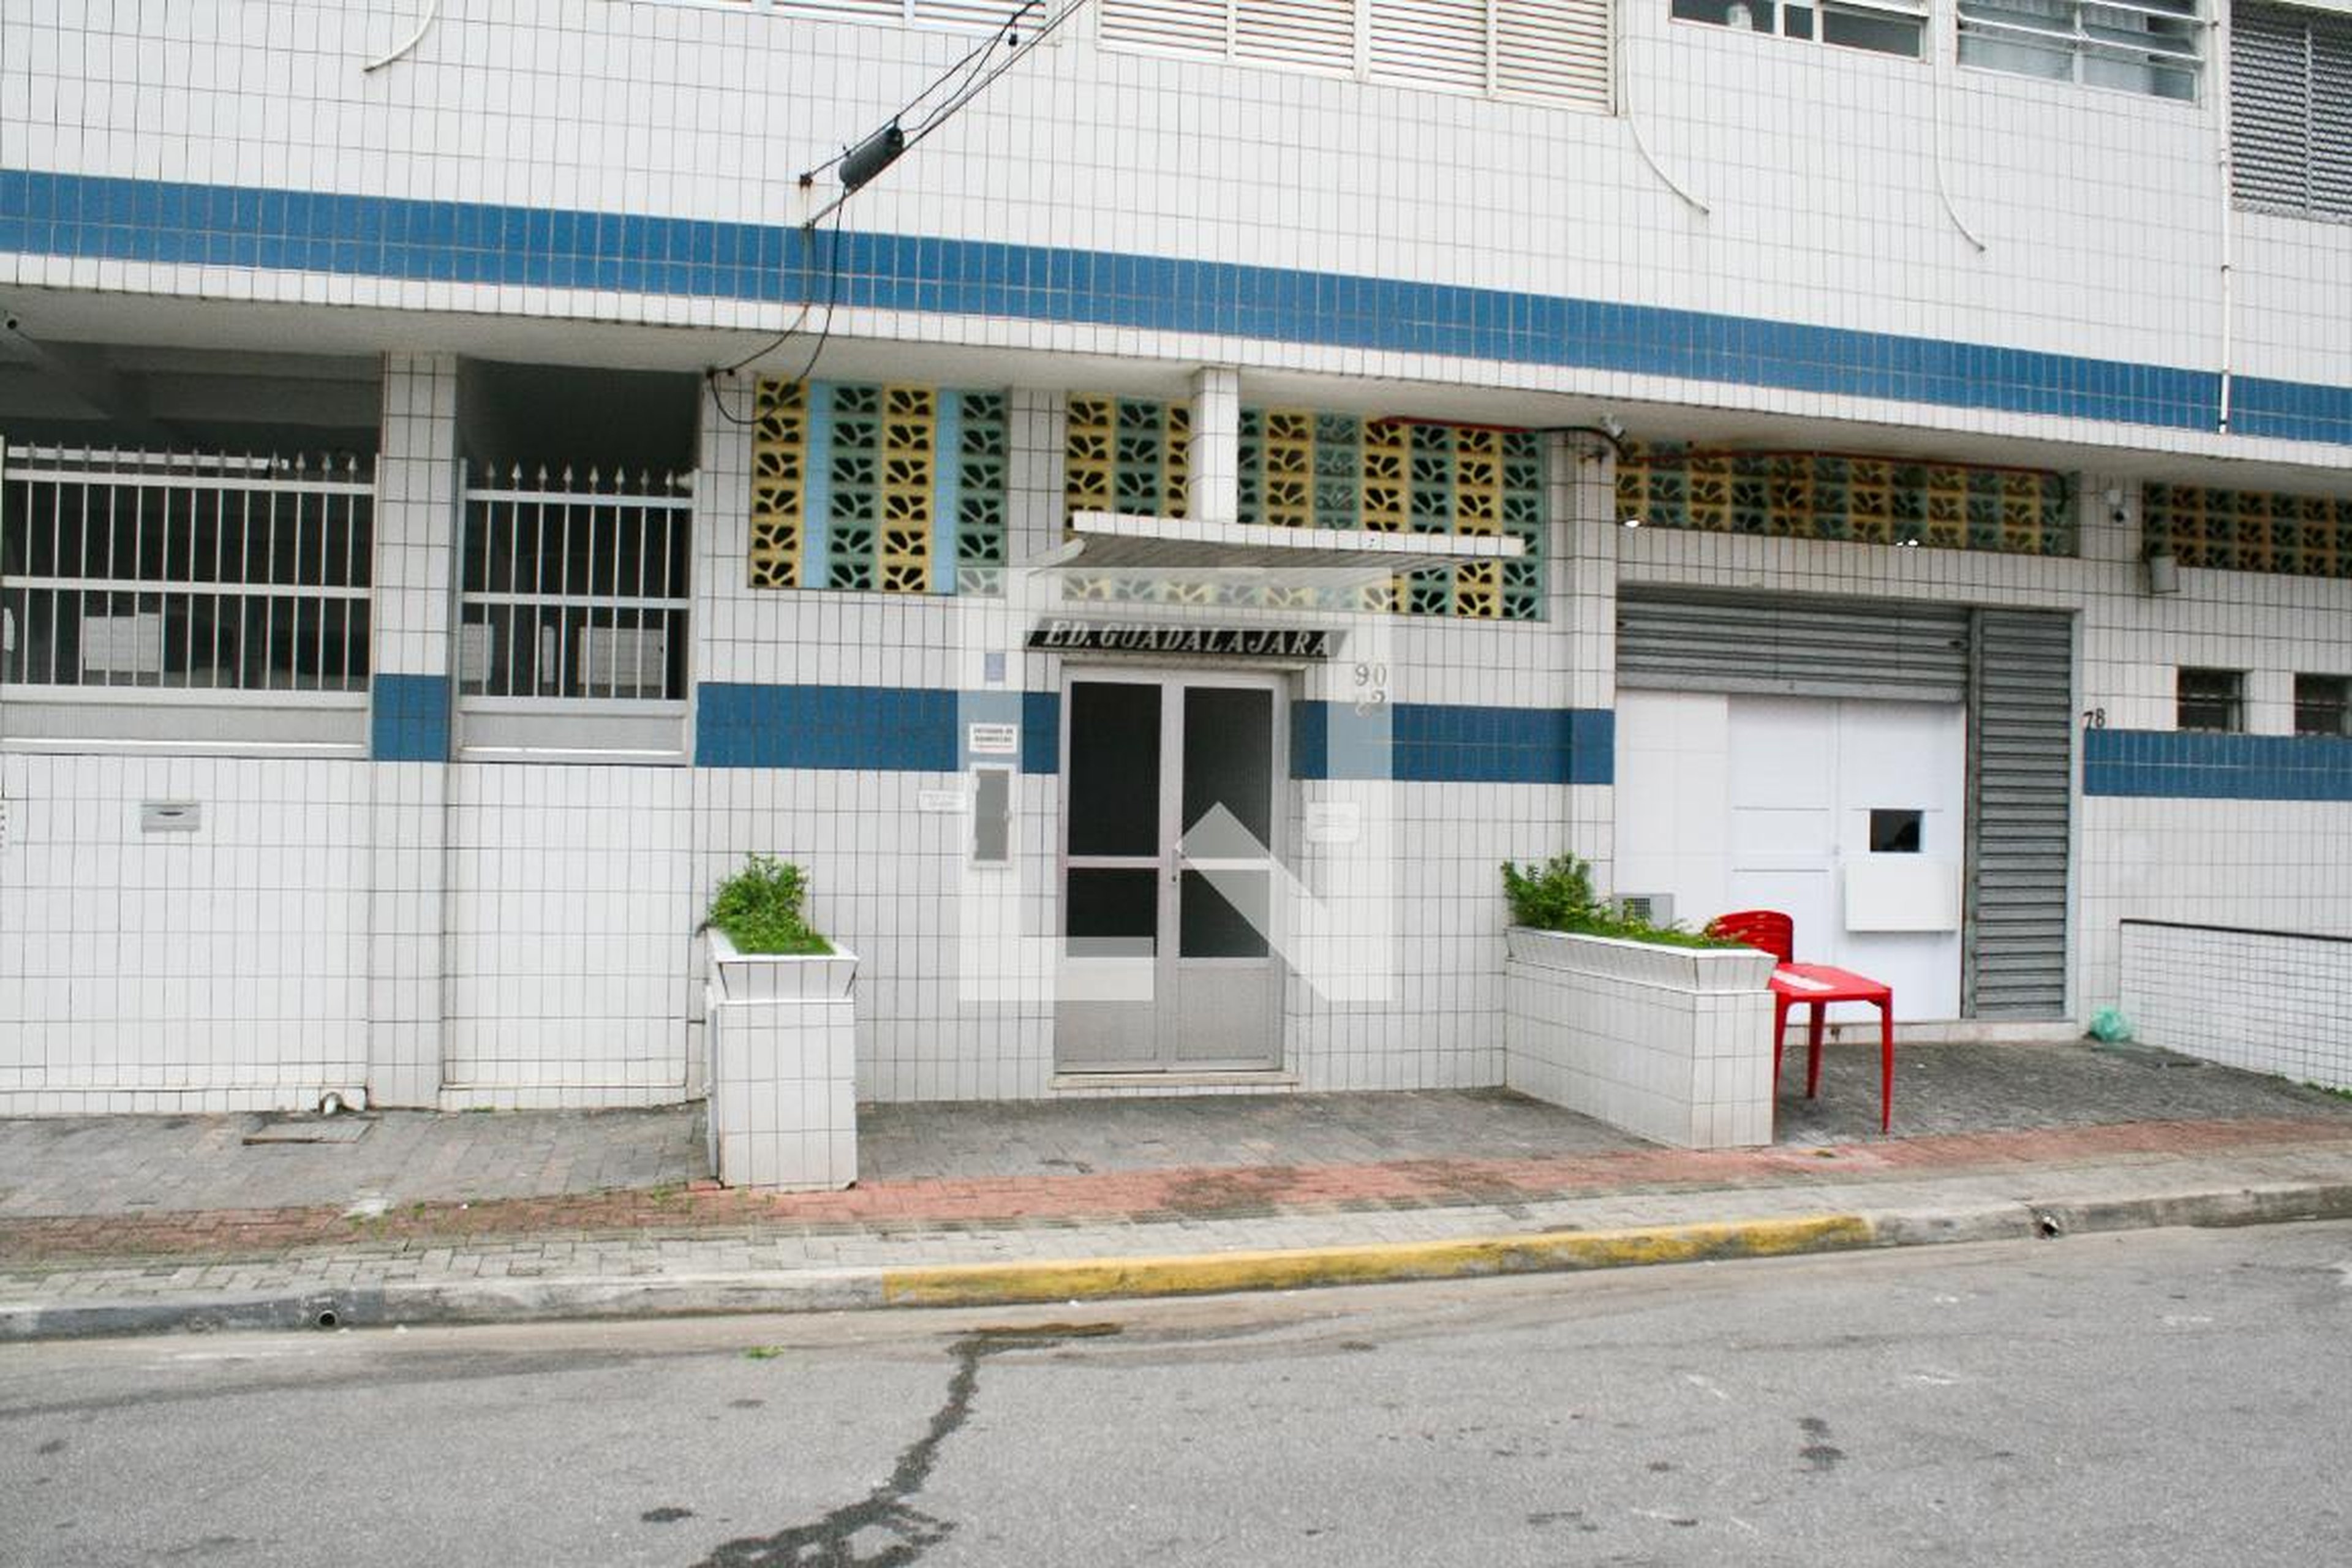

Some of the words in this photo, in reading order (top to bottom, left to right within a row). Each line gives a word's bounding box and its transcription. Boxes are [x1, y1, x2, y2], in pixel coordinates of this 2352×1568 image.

[1043, 620, 1091, 646] ED.
[1099, 622, 1330, 656] GUADALAJARA
[1355, 662, 1387, 687] 90
[2083, 707, 2106, 731] 78
